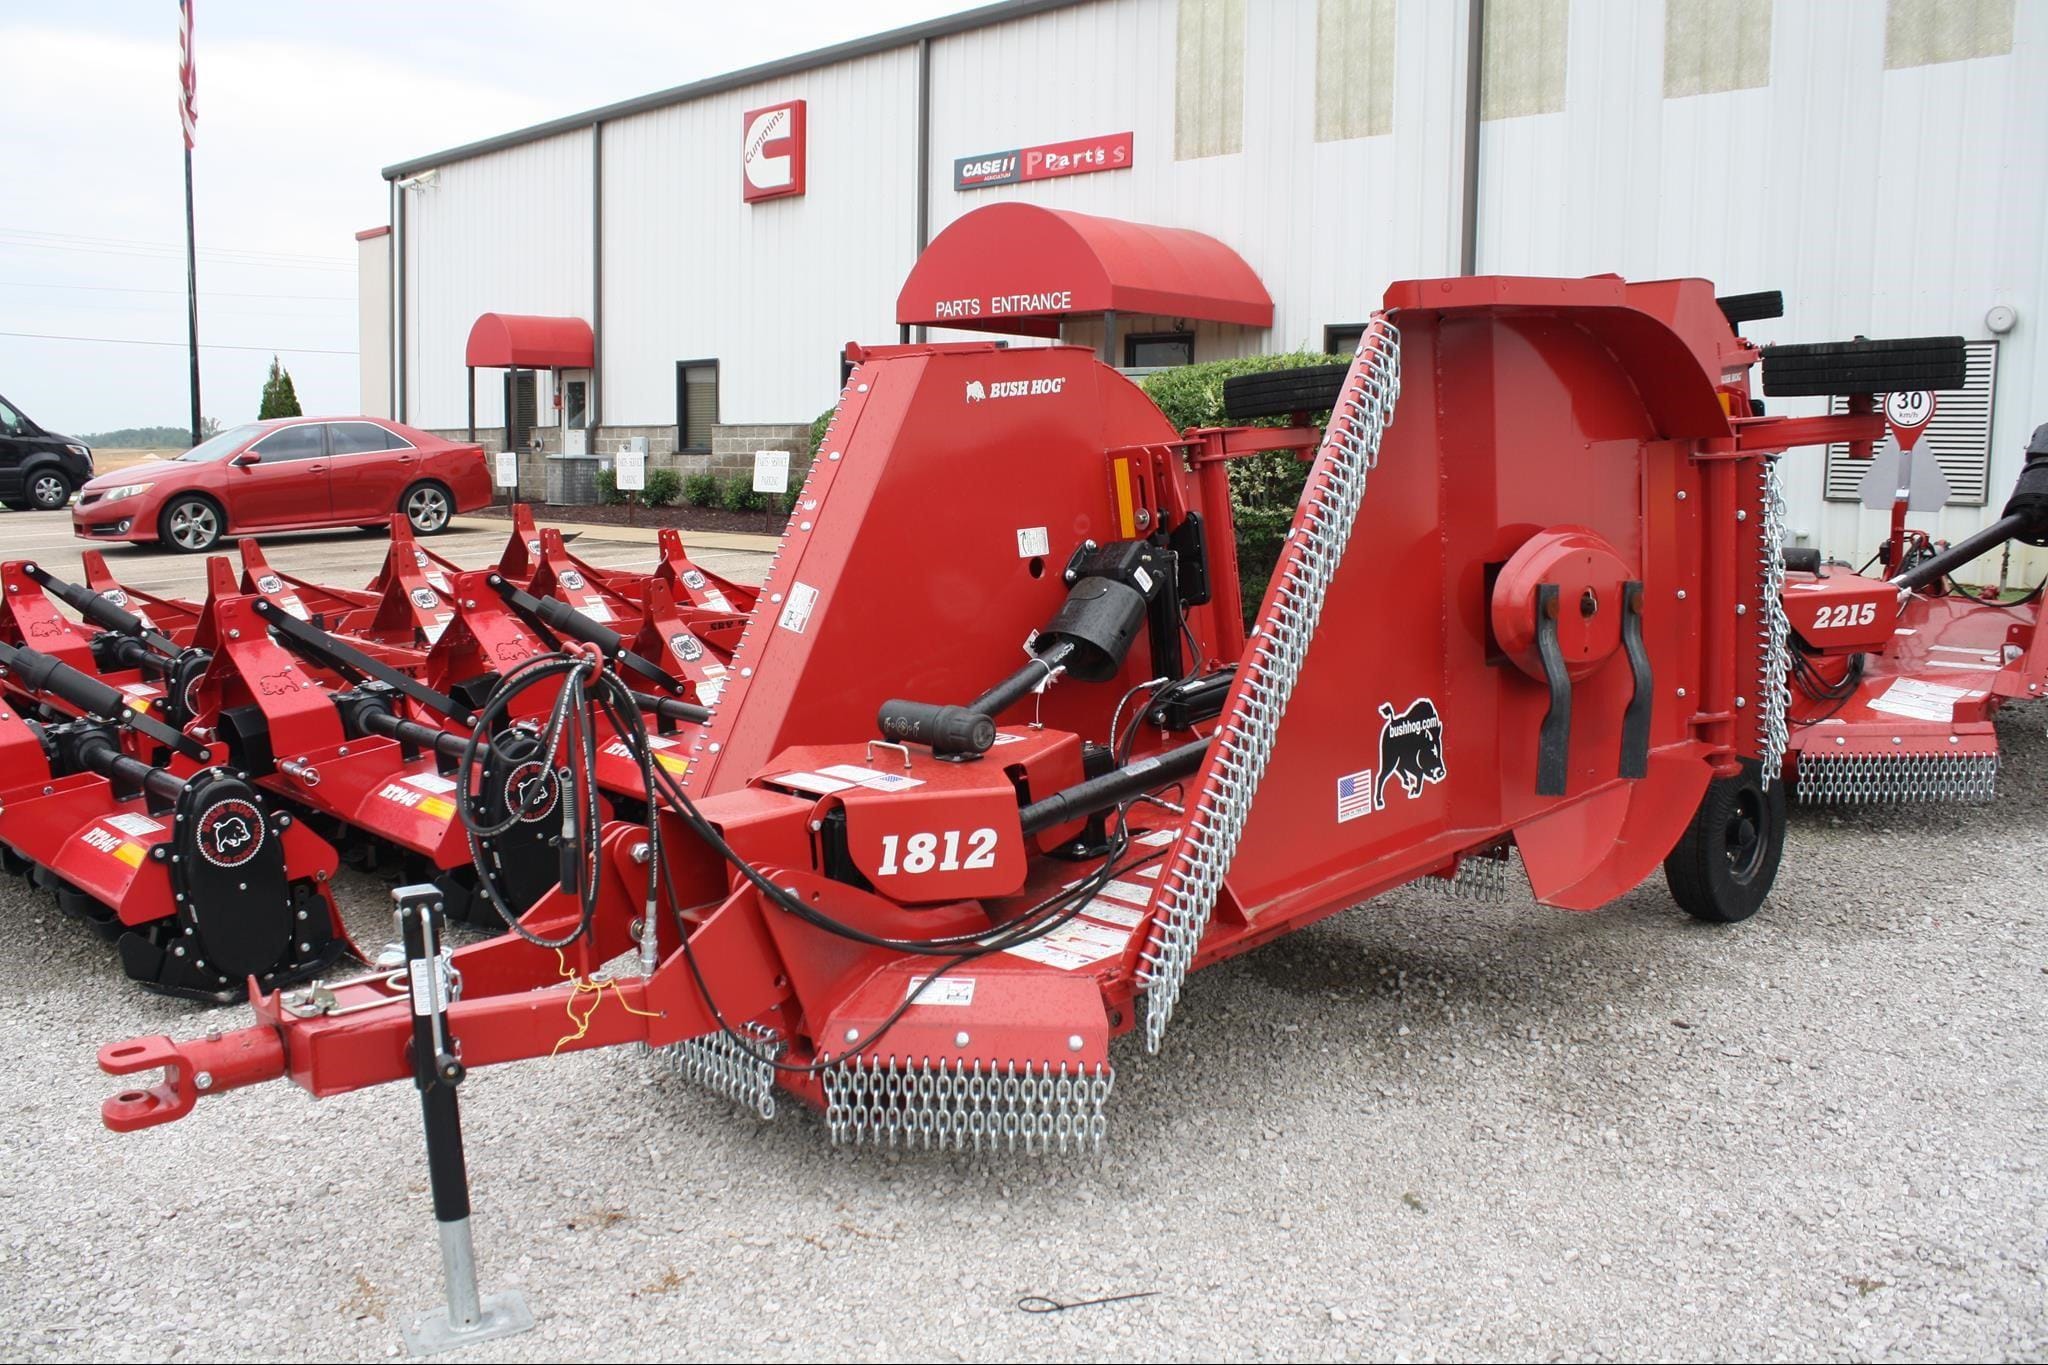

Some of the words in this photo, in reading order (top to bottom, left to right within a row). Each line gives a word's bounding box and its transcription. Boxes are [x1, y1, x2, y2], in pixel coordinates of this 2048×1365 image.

[745, 111, 785, 164] Cummins
[962, 159, 1002, 177] CASE
[935, 298, 981, 318] PARTS
[991, 291, 1072, 314] ENTRANCE
[989, 380, 1029, 398] BUSH
[1030, 378, 1062, 394] HOG
[1897, 391, 1922, 410] 30
[1898, 411, 1919, 419] km/h
[1812, 602, 1877, 629] 2215
[1389, 717, 1437, 738] bushhog.com
[80, 826, 122, 854] RT84G
[878, 827, 998, 876] 1812
